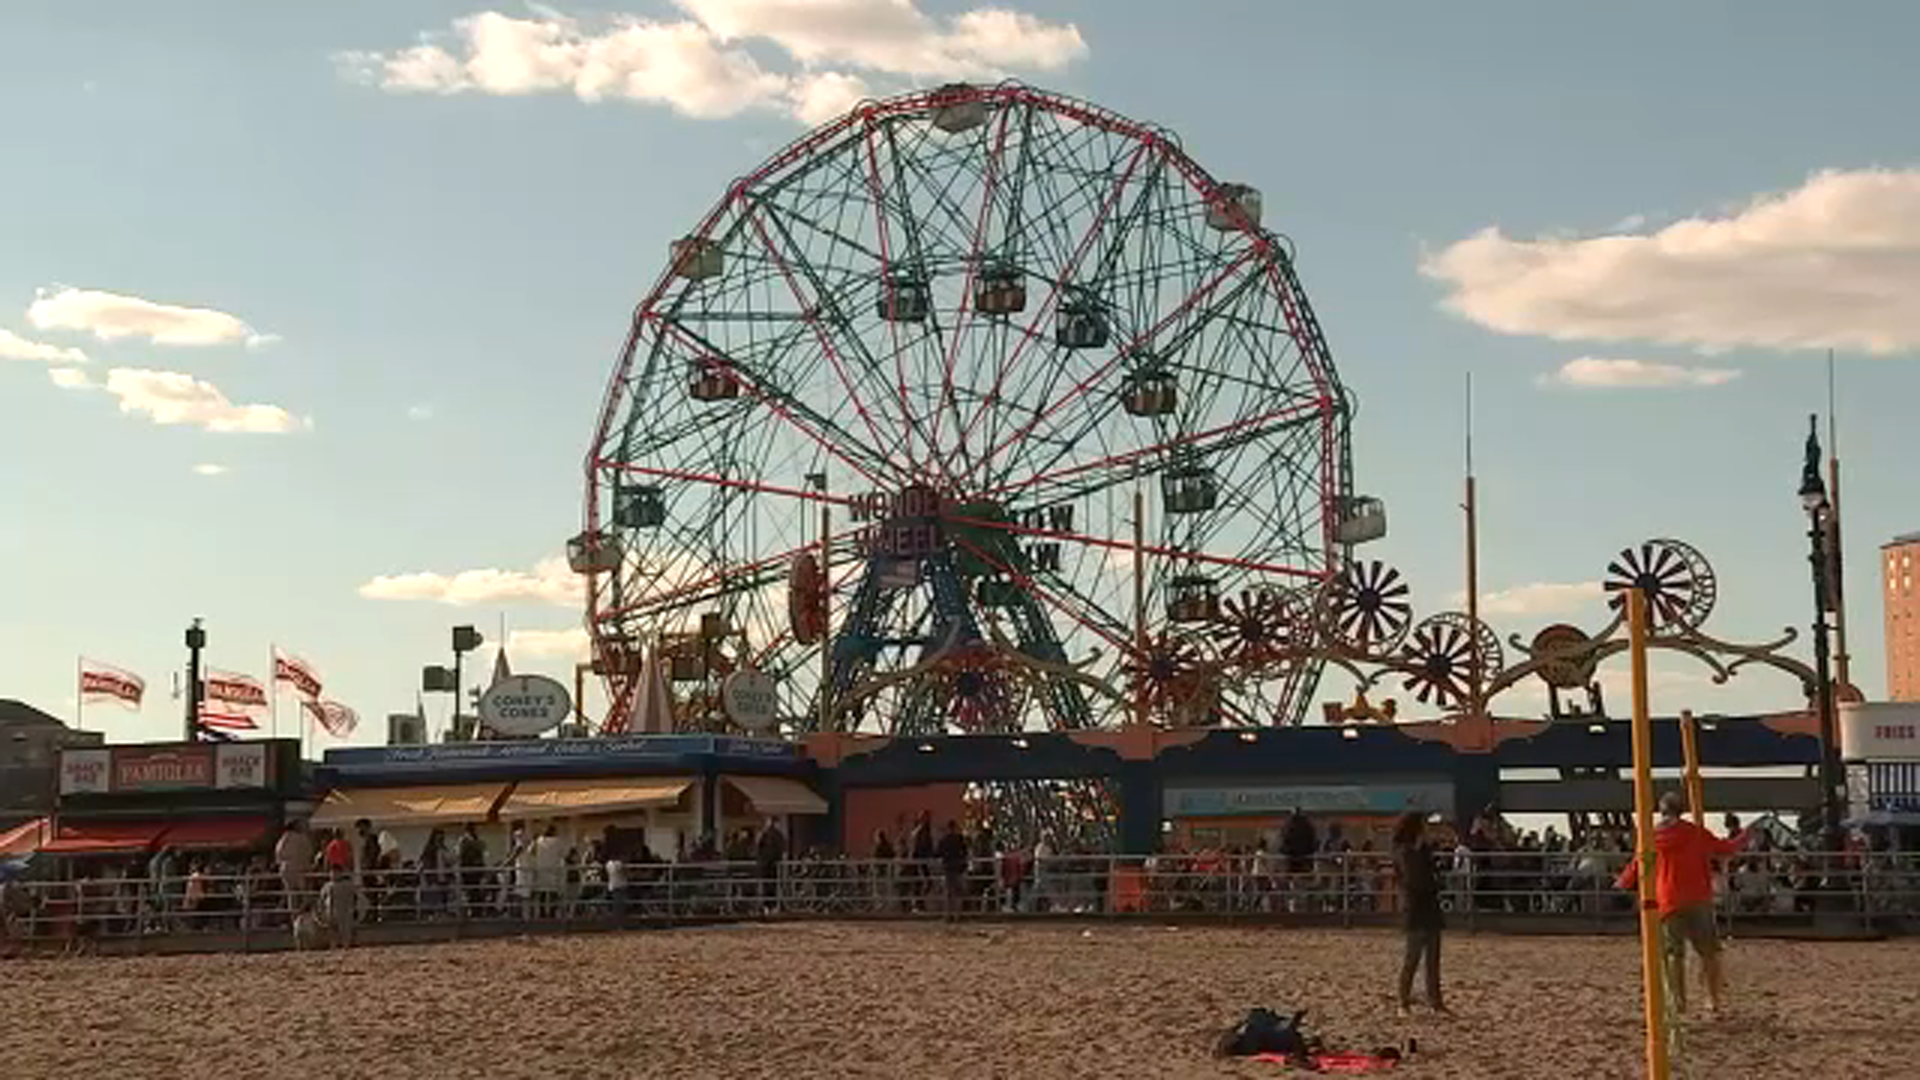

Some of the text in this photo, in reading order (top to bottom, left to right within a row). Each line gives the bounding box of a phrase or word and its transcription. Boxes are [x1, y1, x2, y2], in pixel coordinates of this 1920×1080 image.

[492, 695, 555, 707] CONEY'S
[500, 708, 548, 718] CONES
[1875, 726, 1915, 738] FRIES
[122, 764, 205, 783] FAMIGLIA
